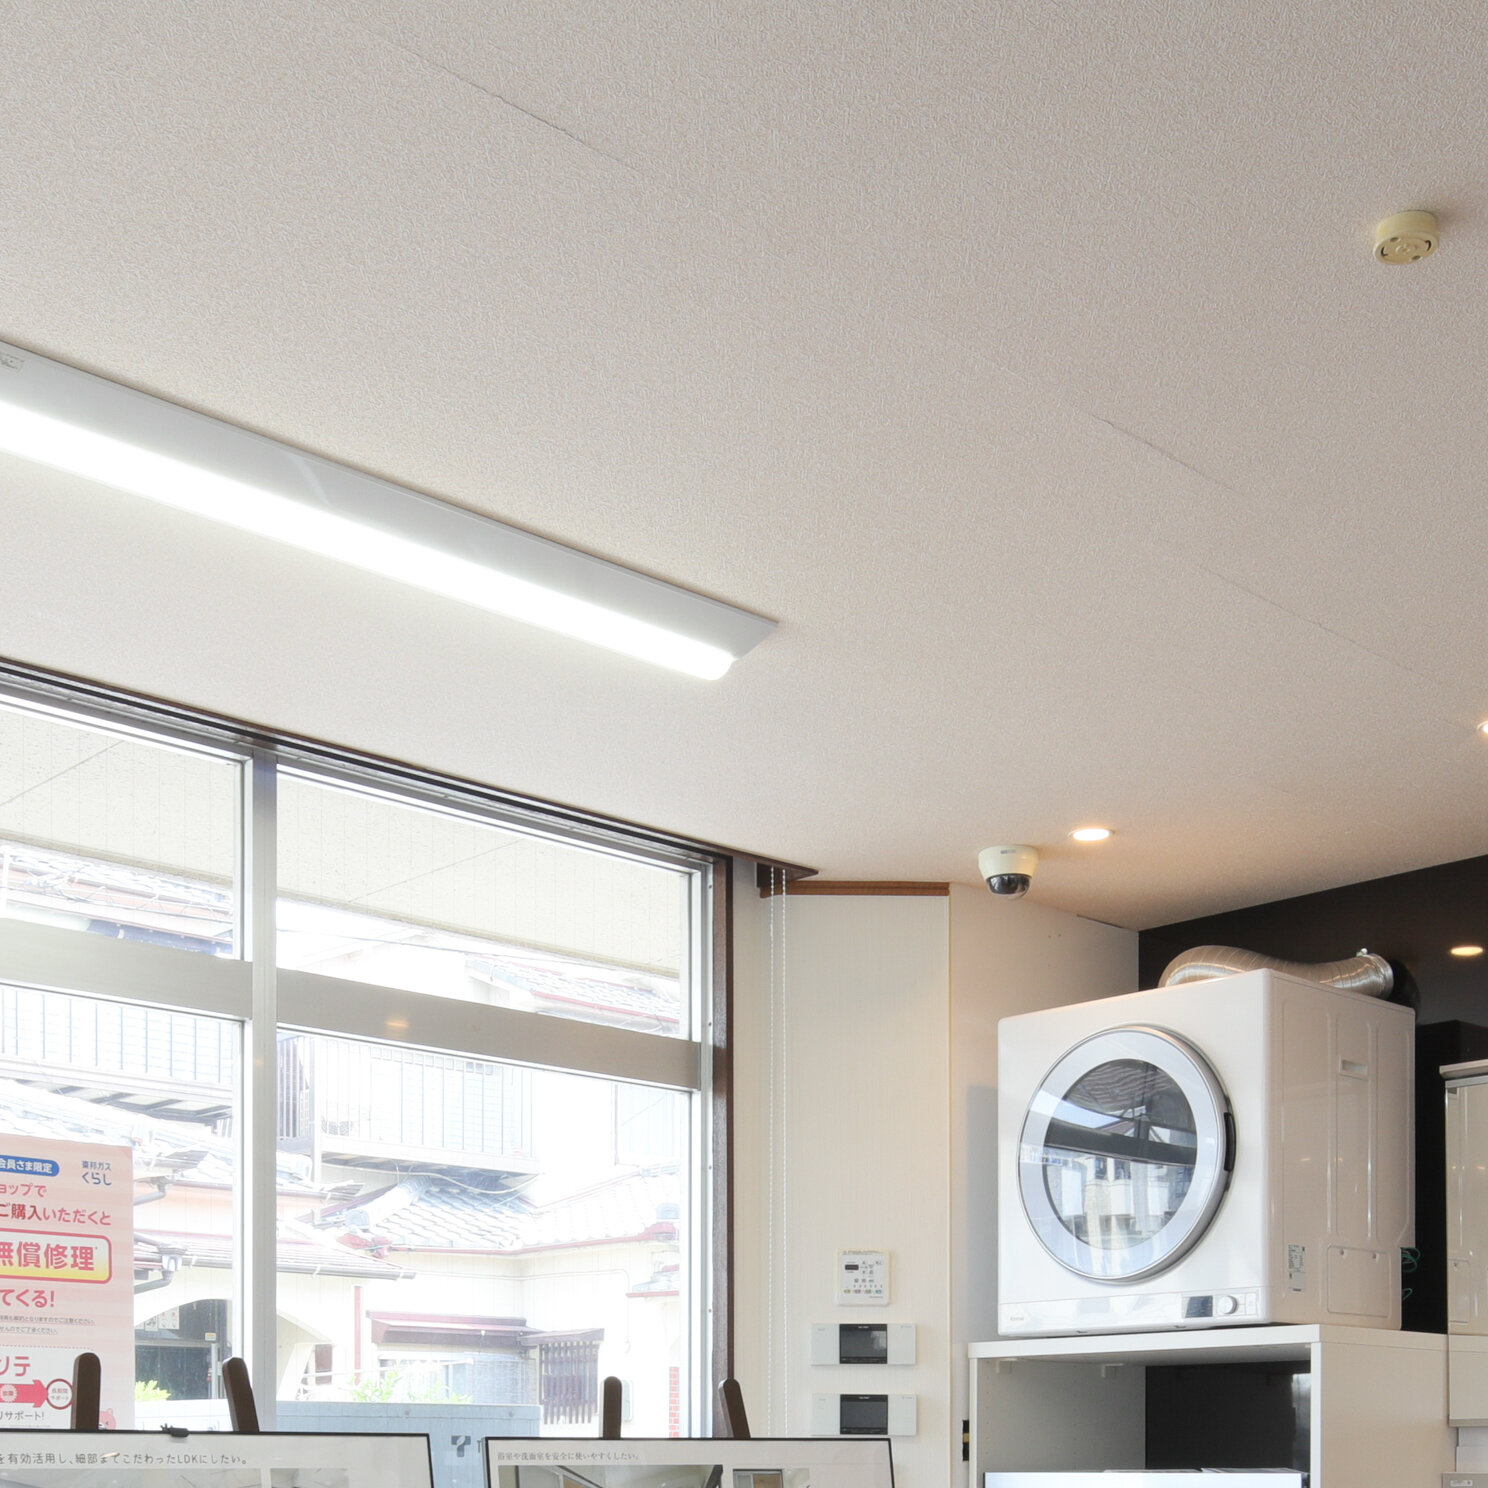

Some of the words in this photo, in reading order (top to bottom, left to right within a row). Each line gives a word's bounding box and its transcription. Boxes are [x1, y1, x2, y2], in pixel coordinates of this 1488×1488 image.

[81, 1160, 112, 1172] 東邦ガス
[81, 1172, 113, 1187] くらし
